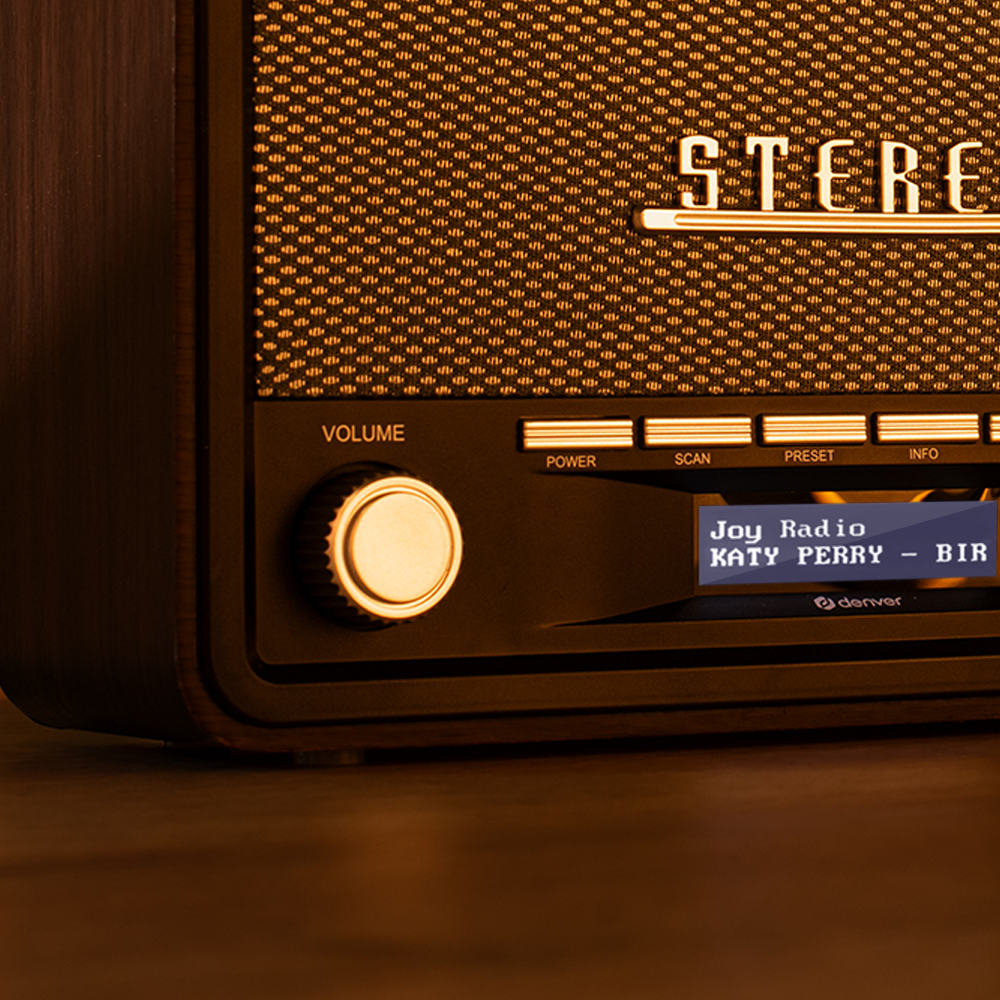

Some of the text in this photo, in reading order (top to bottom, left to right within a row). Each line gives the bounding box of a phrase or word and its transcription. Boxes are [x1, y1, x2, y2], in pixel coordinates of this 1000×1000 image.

[321, 424, 405, 443] VOLUME
[674, 452, 711, 466] SCAN
[784, 449, 835, 463] PRESET
[909, 447, 939, 460] INFO
[546, 454, 597, 469] POWER
[710, 518, 866, 545] Joy Radio
[709, 546, 780, 567] KATY
[797, 544, 884, 566] PERRY
[935, 542, 988, 563] BIR
[837, 596, 902, 609] denver
